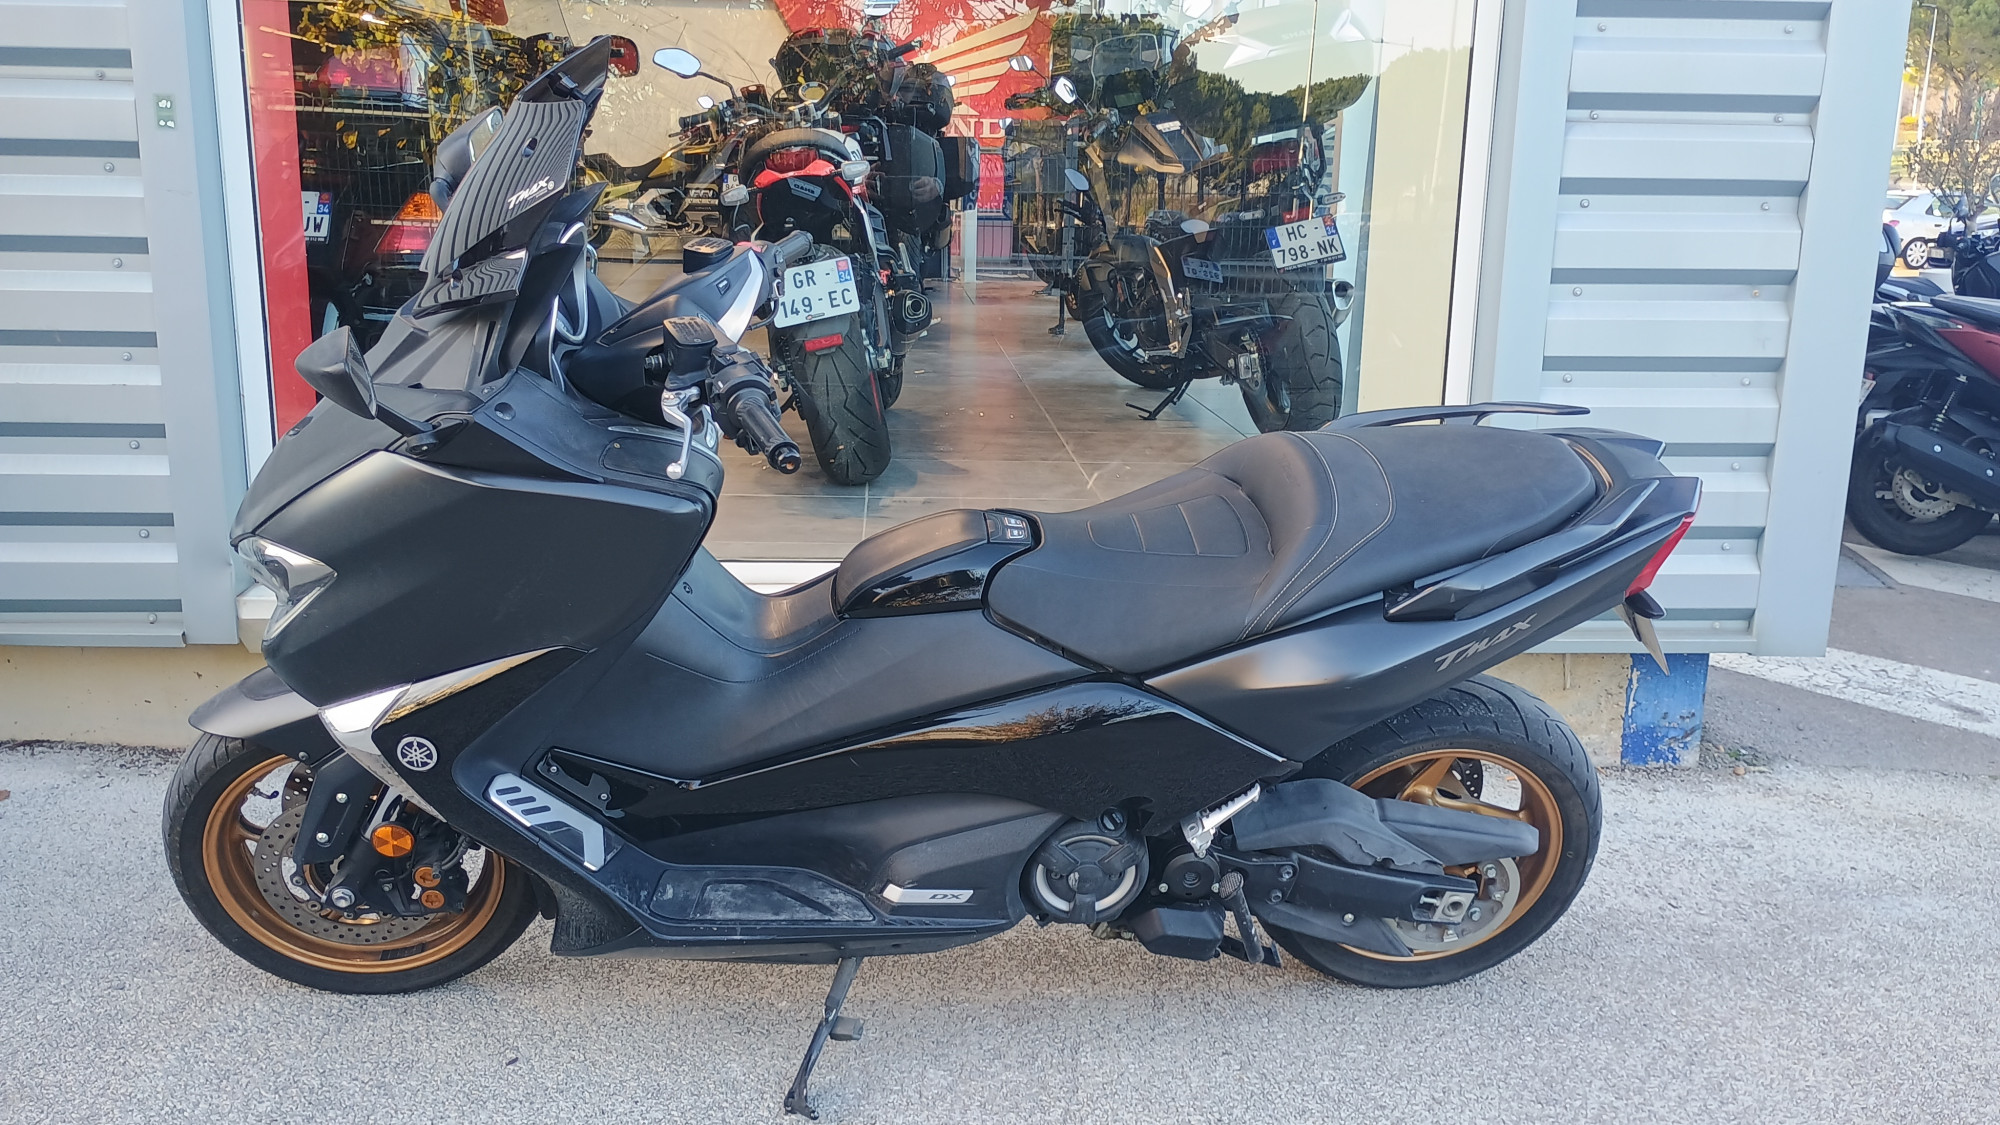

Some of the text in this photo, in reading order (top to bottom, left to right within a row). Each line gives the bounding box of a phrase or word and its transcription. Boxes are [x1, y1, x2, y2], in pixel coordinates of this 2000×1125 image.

[317, 204, 329, 213] 34
[1285, 224, 1307, 242] HC
[1326, 226, 1336, 235] 34
[792, 269, 817, 289] GR
[839, 271, 851, 282] 34
